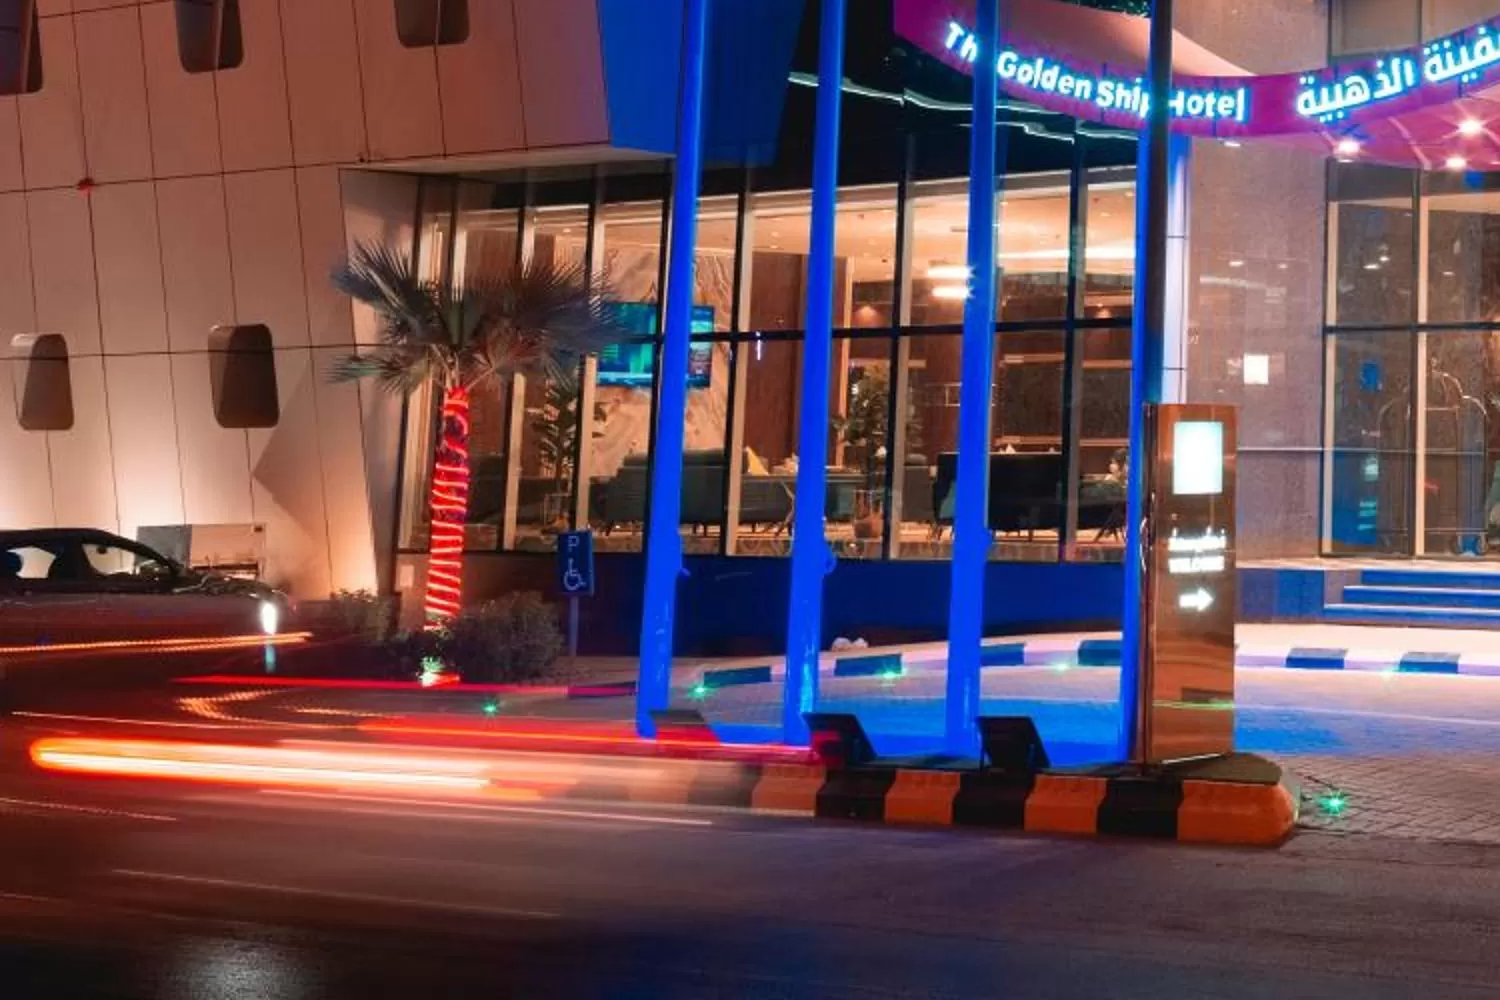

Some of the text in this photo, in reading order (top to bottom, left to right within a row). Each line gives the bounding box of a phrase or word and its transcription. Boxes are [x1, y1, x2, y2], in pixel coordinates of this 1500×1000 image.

[945, 20, 978, 63] Th
[997, 51, 1092, 100] Golden
[1296, 56, 1415, 122] الذهبية
